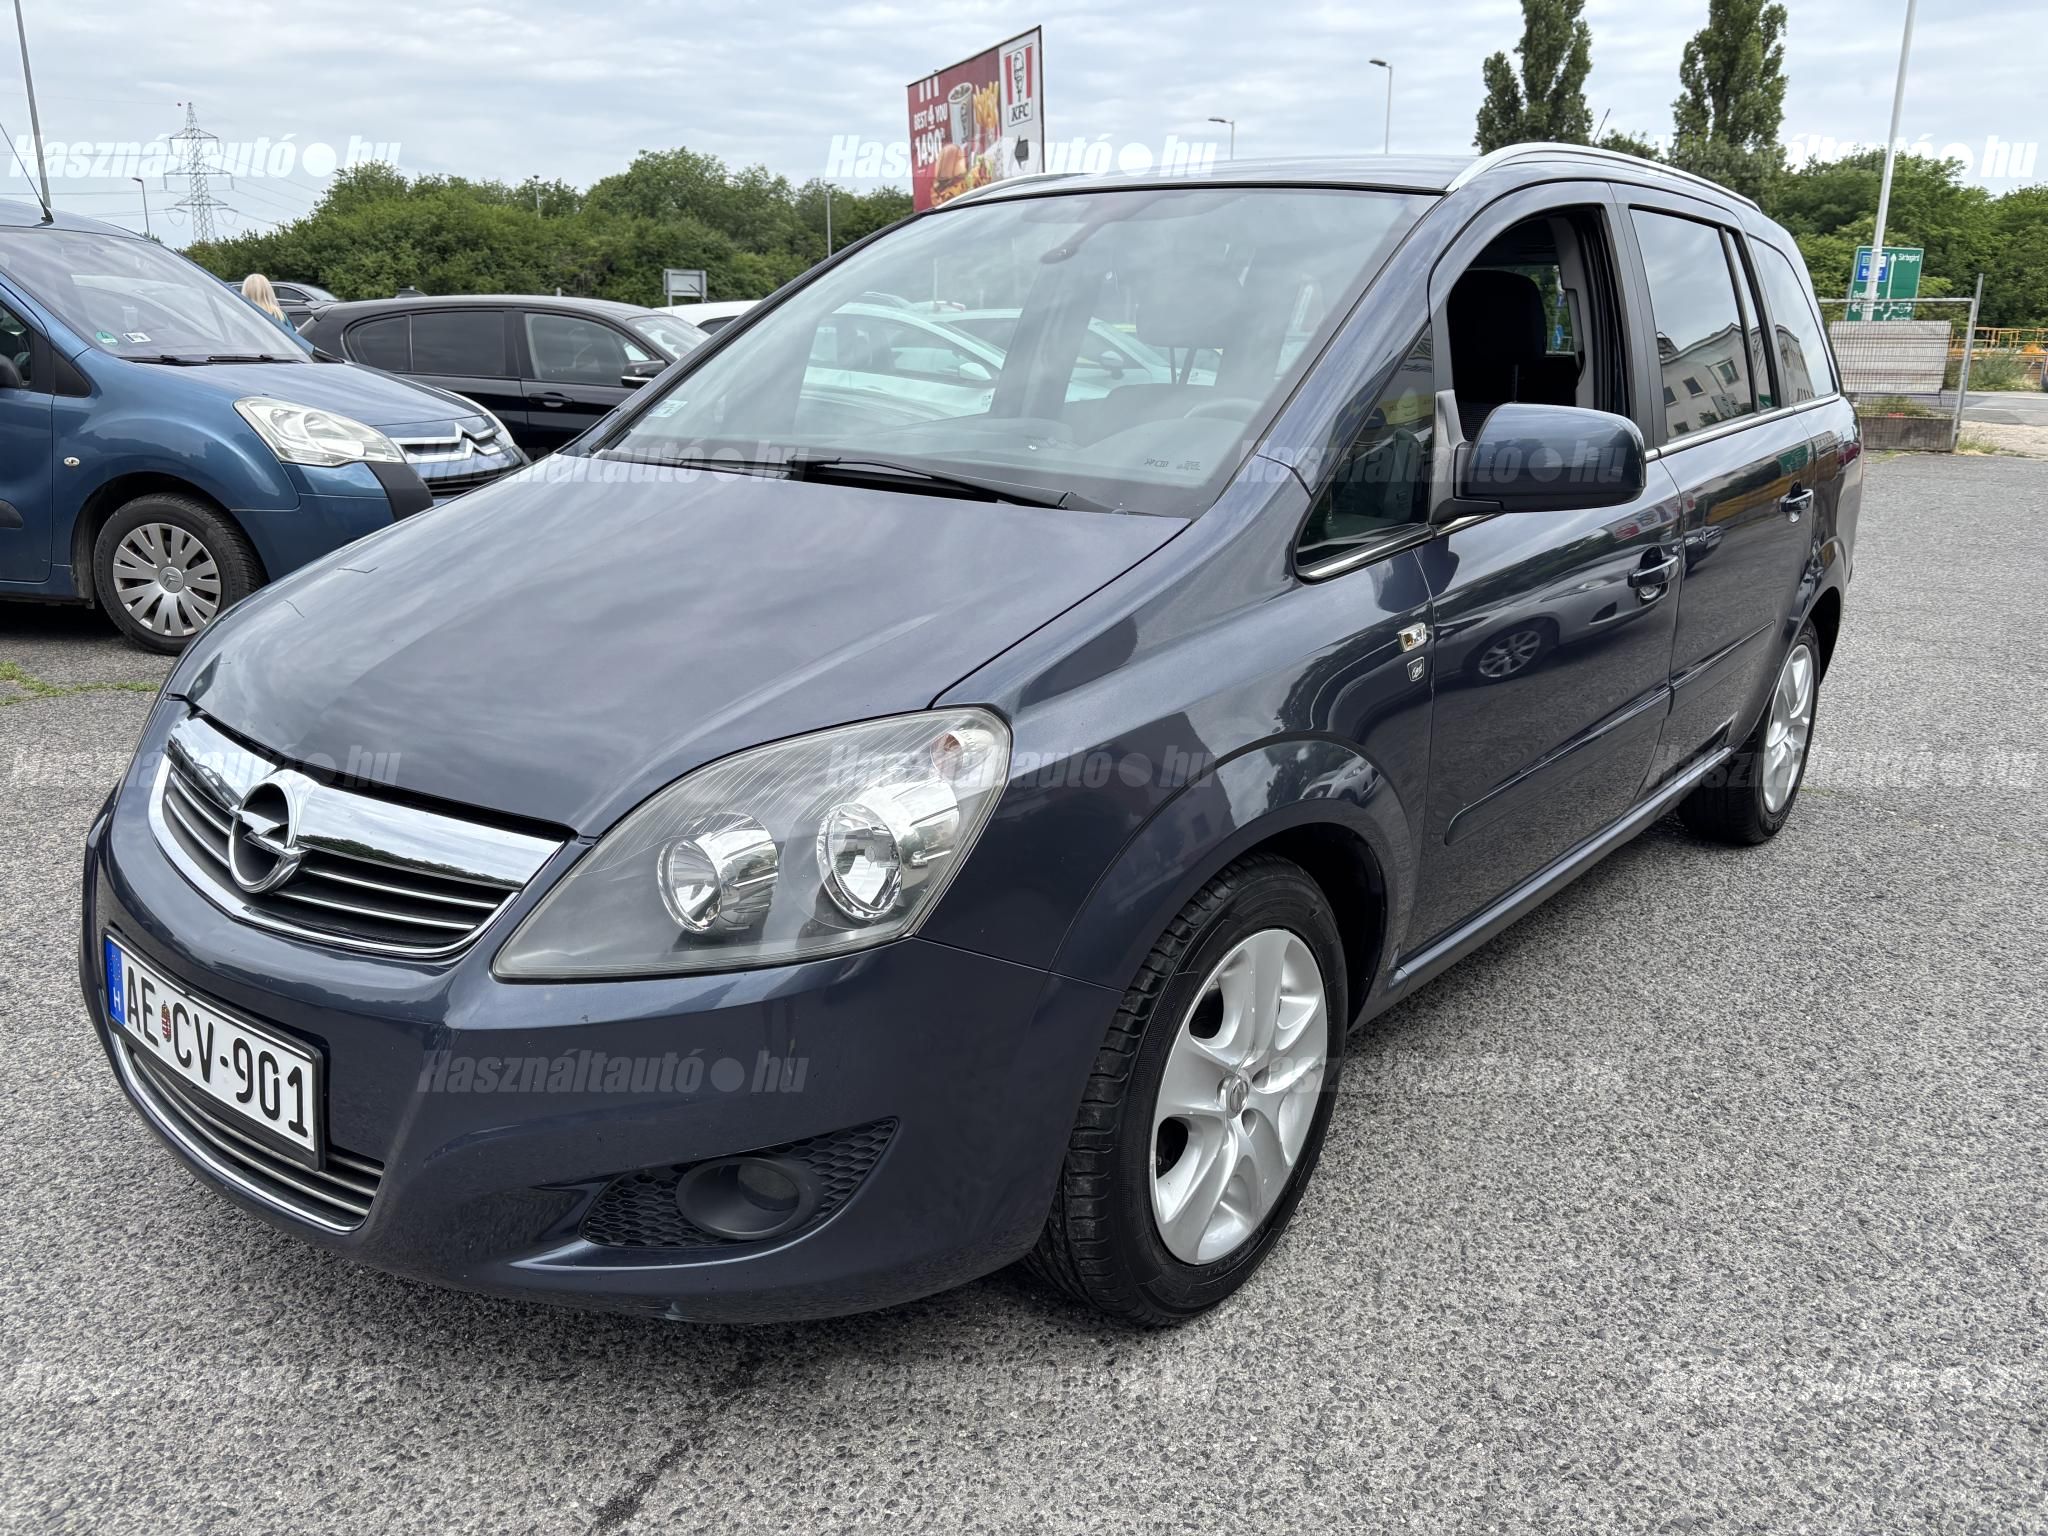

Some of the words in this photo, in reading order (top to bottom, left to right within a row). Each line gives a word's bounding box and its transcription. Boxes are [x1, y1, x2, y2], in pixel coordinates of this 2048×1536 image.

[914, 110, 928, 131] BEST
[934, 102, 948, 123] YOU
[1011, 102, 1030, 122] KFC
[112, 987, 121, 1012] H
